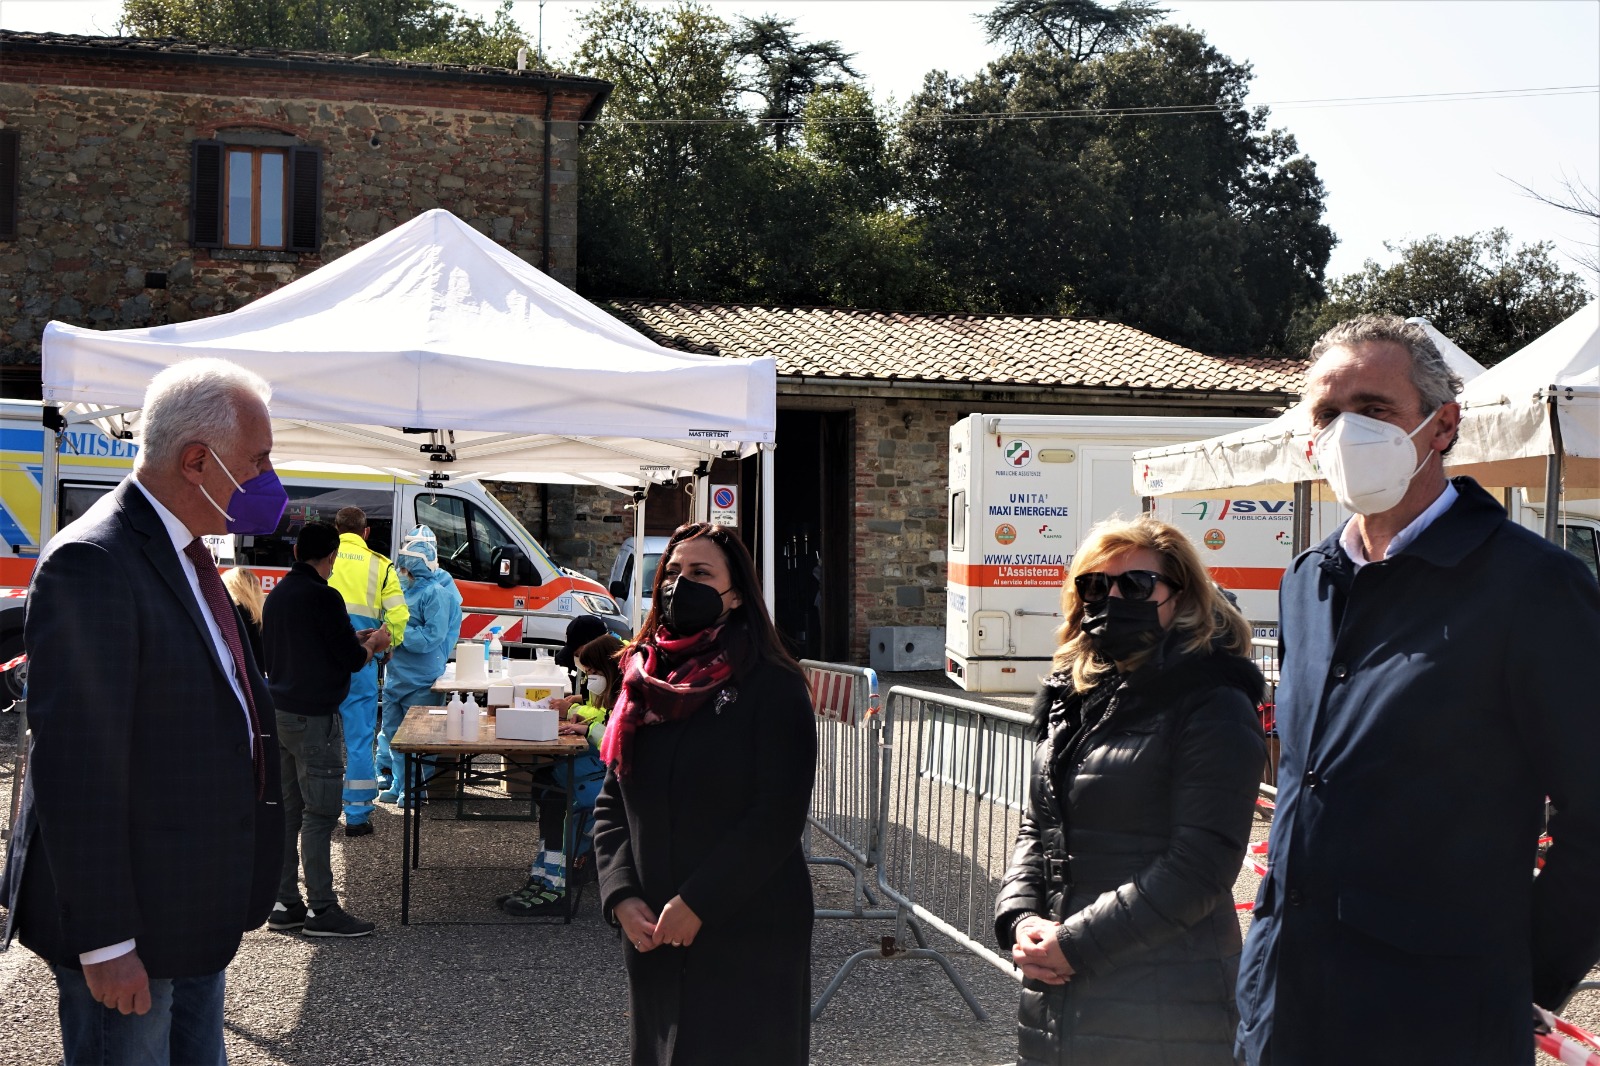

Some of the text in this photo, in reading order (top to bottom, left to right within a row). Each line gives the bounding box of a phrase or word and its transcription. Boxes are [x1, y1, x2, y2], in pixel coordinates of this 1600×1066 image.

[1009, 493, 1048, 504] UNITA'
[989, 505, 1068, 517] MAXI EMERGENZE
[984, 554, 1074, 565] WWW.SVSITALIA.IT
[998, 566, 1059, 577] L'Assistenza
[1269, 627, 1278, 637] di
